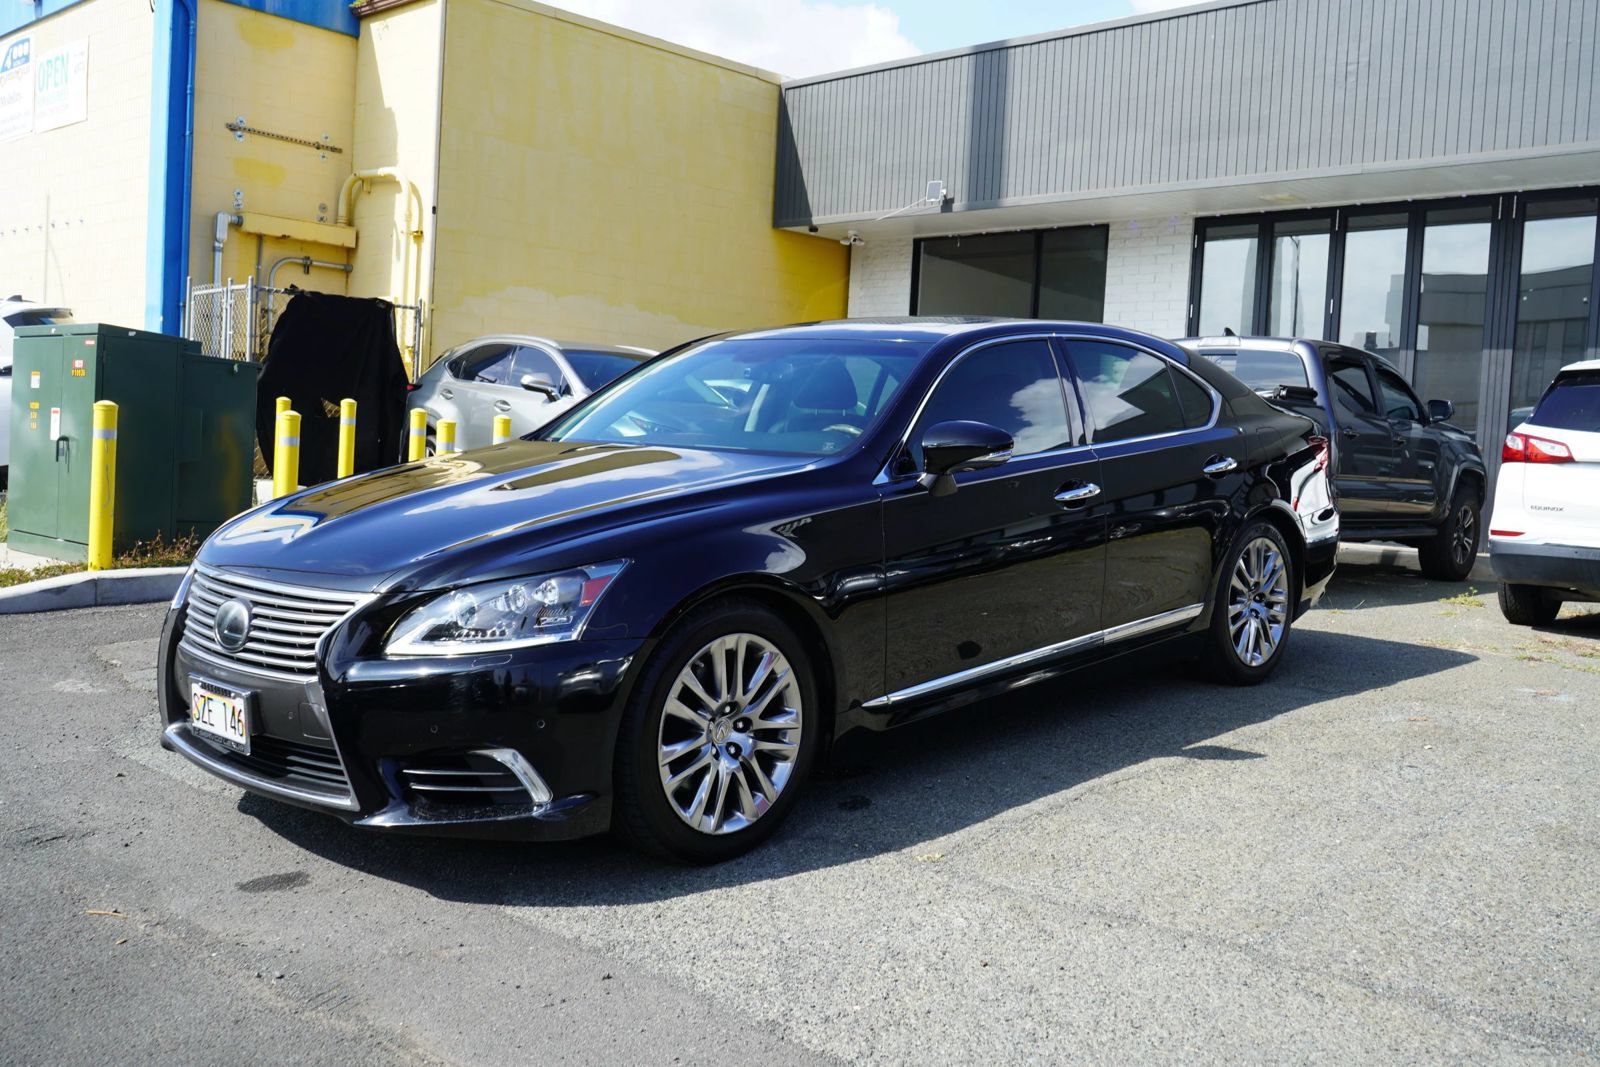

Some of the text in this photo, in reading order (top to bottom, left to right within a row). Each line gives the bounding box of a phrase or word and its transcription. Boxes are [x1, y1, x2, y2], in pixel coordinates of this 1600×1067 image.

[38, 52, 70, 92] OPEN
[193, 692, 244, 737] SZE 146
